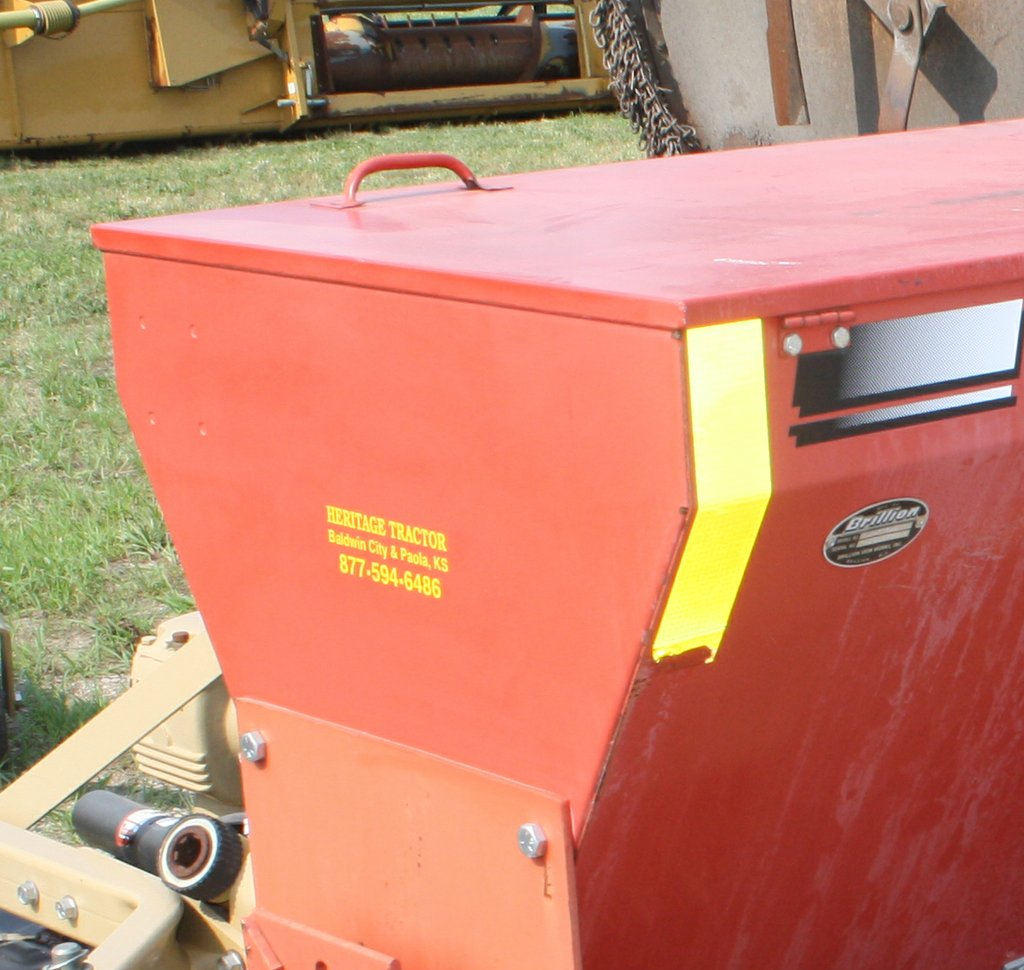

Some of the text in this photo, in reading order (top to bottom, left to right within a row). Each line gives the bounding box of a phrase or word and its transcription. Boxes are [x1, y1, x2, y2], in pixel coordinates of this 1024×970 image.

[326, 505, 447, 552] HERITAGE TRACTOR
[845, 506, 920, 532] Brillion
[328, 529, 448, 572] Baldwin City & Paola, KS
[339, 553, 441, 599] 877-594-6486
